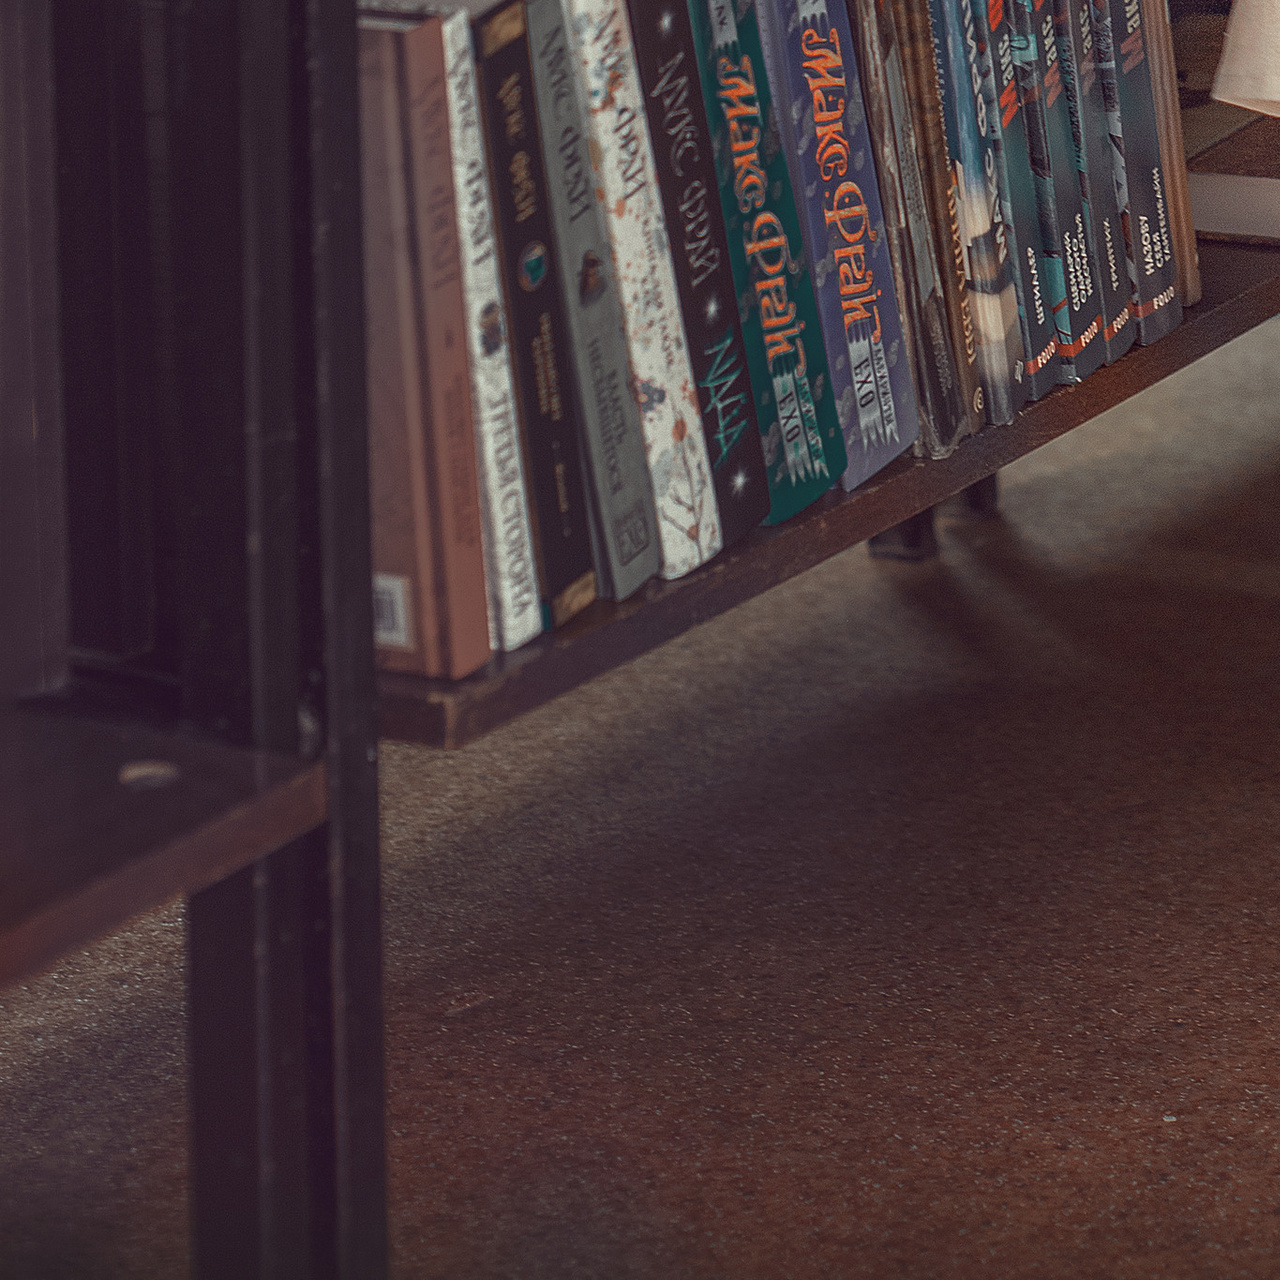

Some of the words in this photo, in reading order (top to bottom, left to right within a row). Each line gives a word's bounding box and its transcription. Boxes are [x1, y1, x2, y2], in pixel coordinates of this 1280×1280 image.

[990, 33, 1020, 128] Макс
[1033, 13, 1065, 108] Макс
[1069, 3, 1099, 96] Макс
[1139, 214, 1155, 275] НАЗОВУ
[1152, 165, 1172, 262] ГАНТЕНБАЙН
[1070, 237, 1087, 303] ОДНОГО
[1102, 217, 1119, 291] ТРИПТИХ
[1152, 231, 1164, 267] СЕБЯ
[1026, 245, 1046, 325] ШТИЛЛЕР
[1152, 286, 1175, 310] FOLIO
[1080, 321, 1099, 347] FOLIO
[1112, 307, 1130, 333] FOLIO
[1037, 341, 1056, 368] FOLIO
